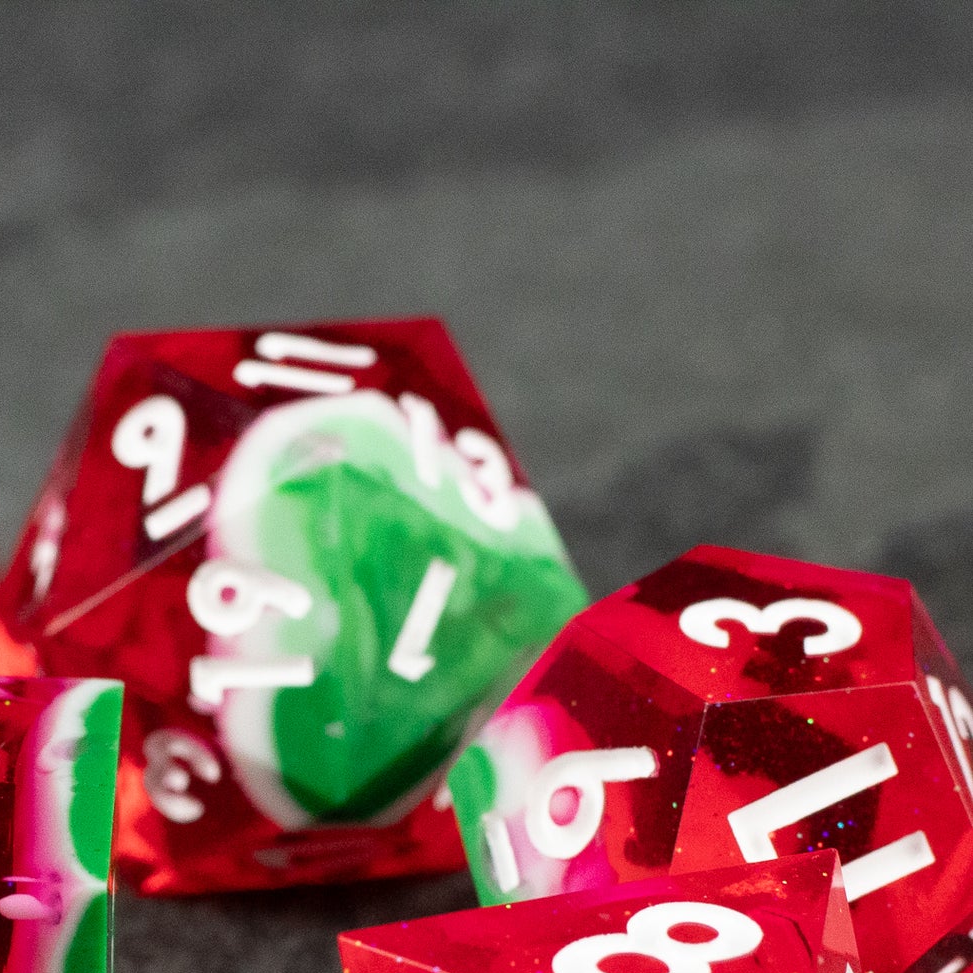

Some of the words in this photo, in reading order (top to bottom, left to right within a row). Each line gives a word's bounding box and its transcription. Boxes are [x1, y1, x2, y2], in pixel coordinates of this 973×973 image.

[233, 333, 377, 393] 11
[398, 391, 522, 531] 13
[187, 559, 315, 706] 19
[679, 598, 862, 655] 3
